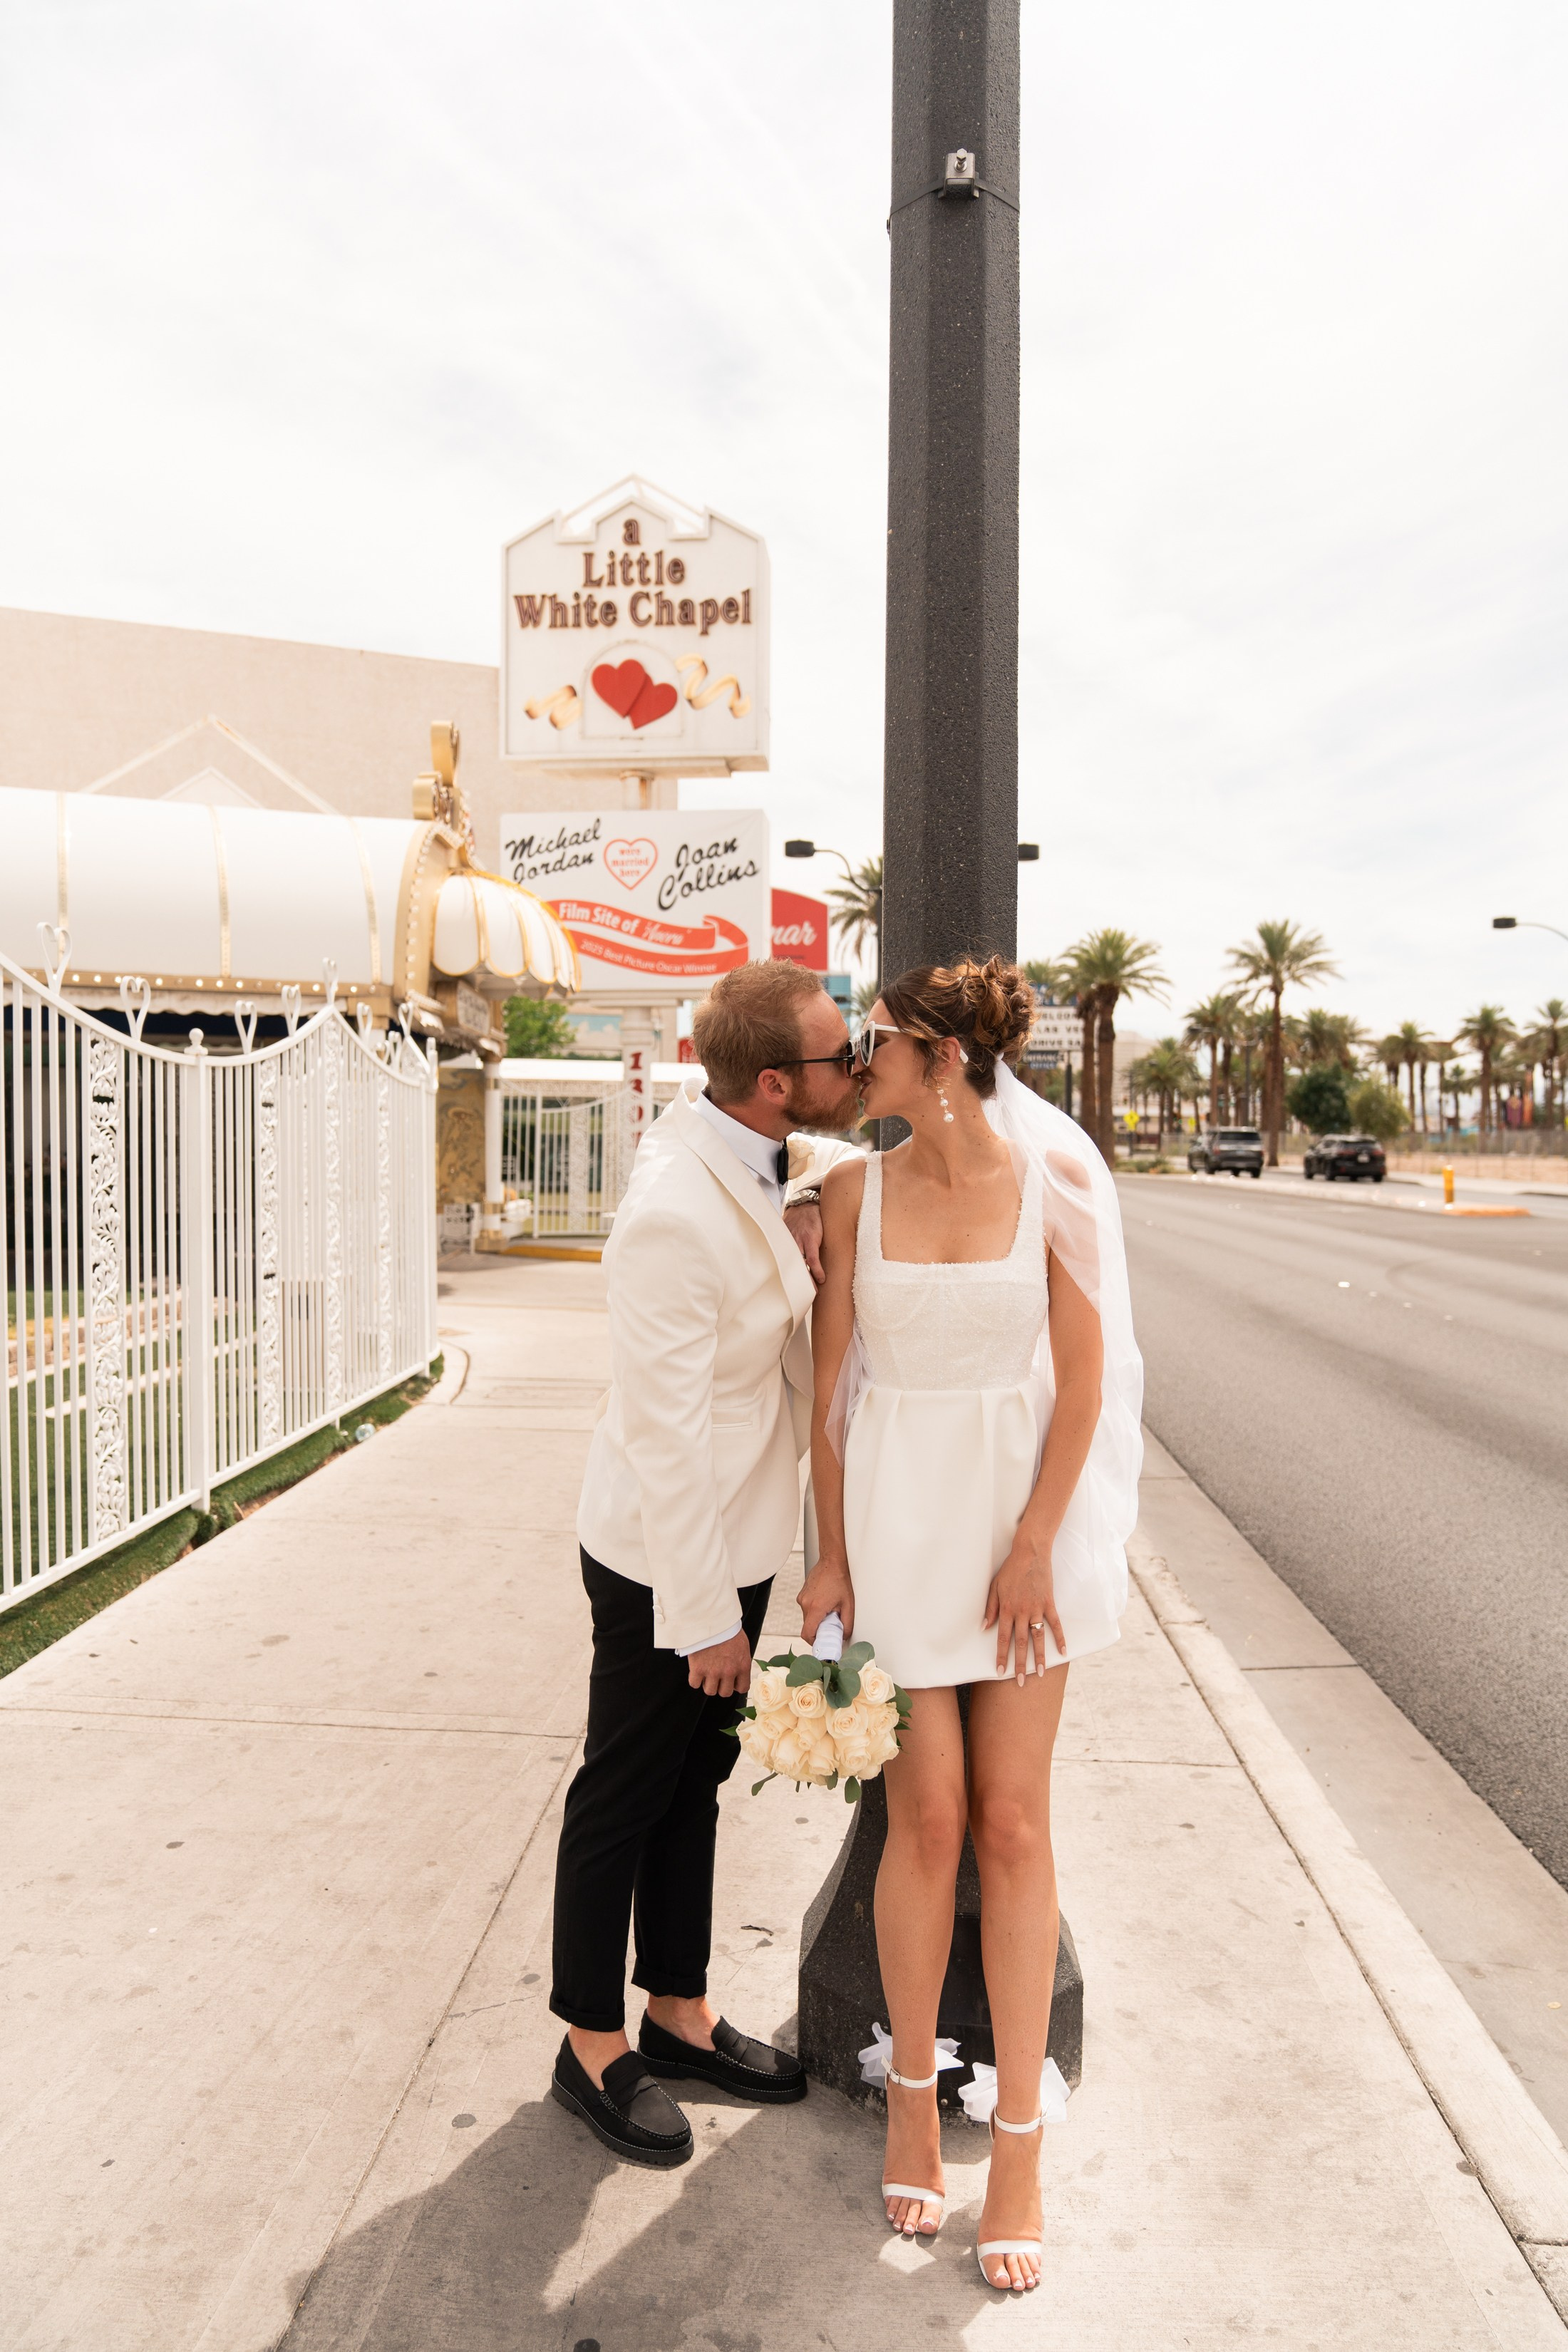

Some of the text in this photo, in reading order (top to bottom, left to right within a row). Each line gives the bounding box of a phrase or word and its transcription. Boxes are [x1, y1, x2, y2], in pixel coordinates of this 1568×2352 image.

[622, 518, 641, 545] a
[582, 550, 686, 588] Little
[513, 588, 752, 636] White Chapel
[505, 817, 601, 861] Michael
[512, 851, 594, 884] Jordan
[612, 857, 649, 867] married
[675, 837, 738, 882] Joan
[658, 860, 760, 912] Collins
[559, 901, 591, 921] Film
[592, 905, 621, 929] Site
[621, 917, 641, 935] of
[603, 947, 624, 964] Best
[623, 953, 656, 971] Picture
[656, 960, 682, 974] Oscar
[683, 962, 718, 974] Winner
